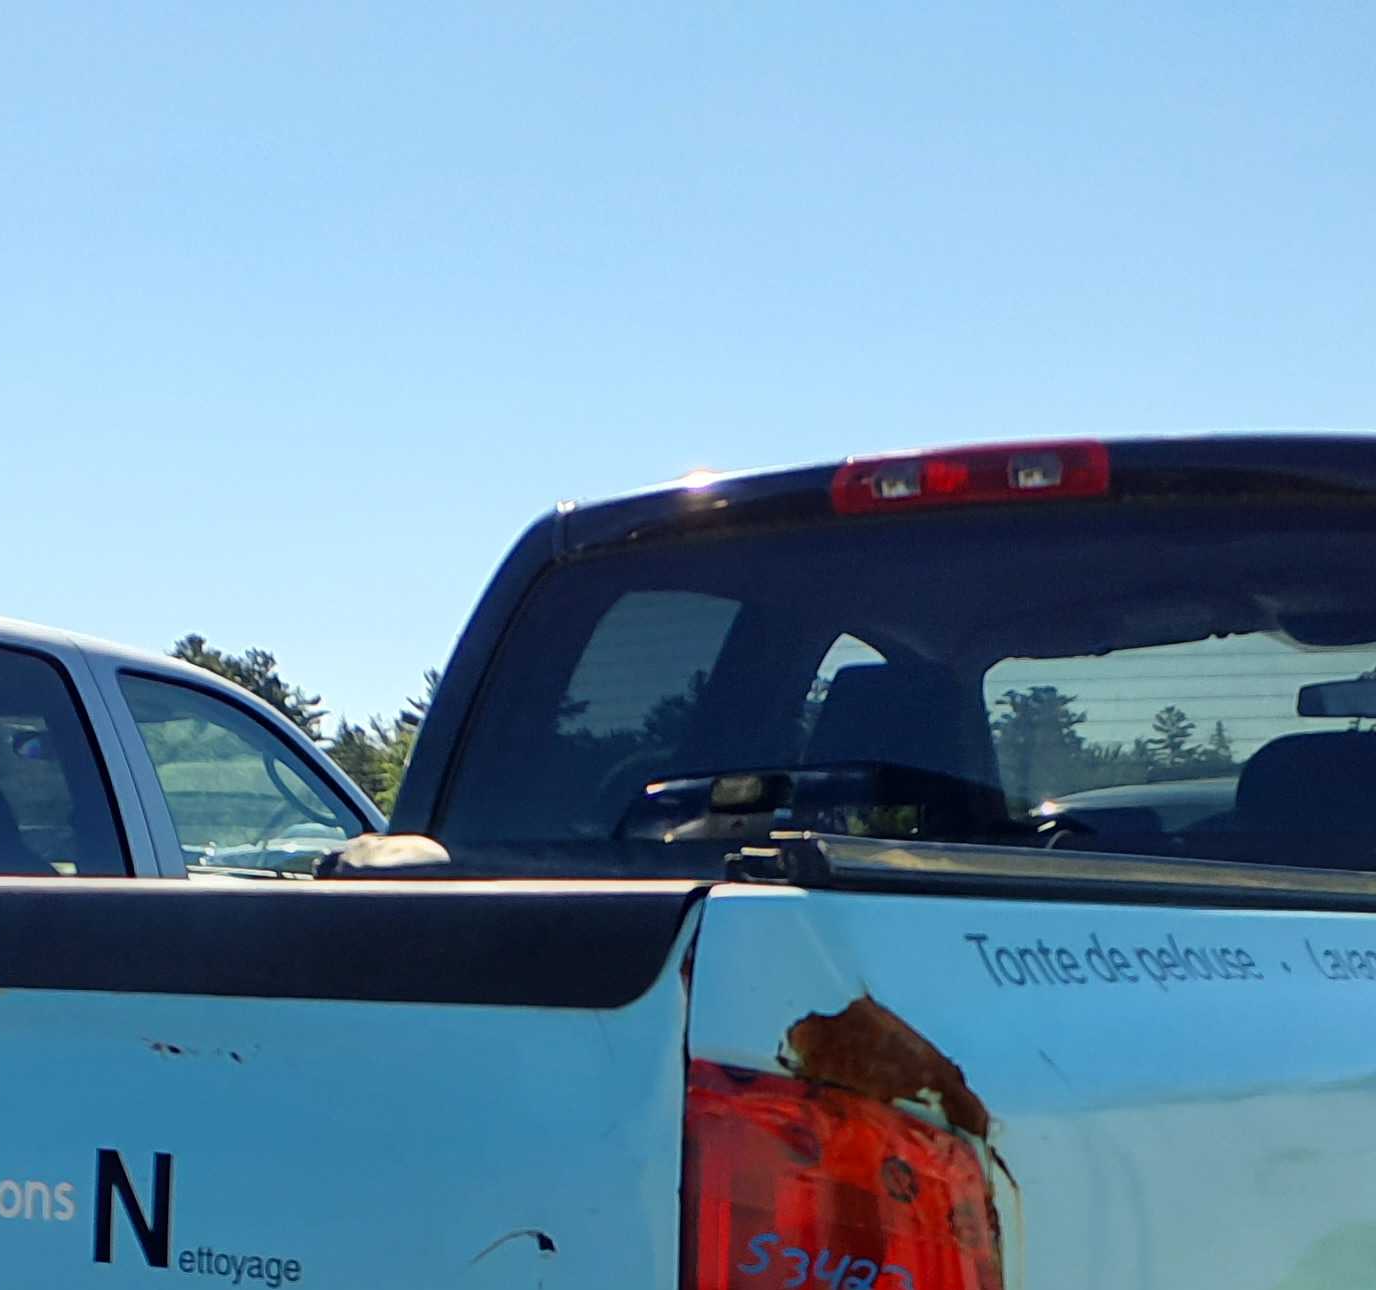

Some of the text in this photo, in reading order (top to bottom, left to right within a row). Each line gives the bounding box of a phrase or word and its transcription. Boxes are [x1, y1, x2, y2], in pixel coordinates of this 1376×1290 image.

[964, 932, 1089, 987] Tonte
[1085, 932, 1140, 984] de
[1135, 932, 1265, 993] pelouse
